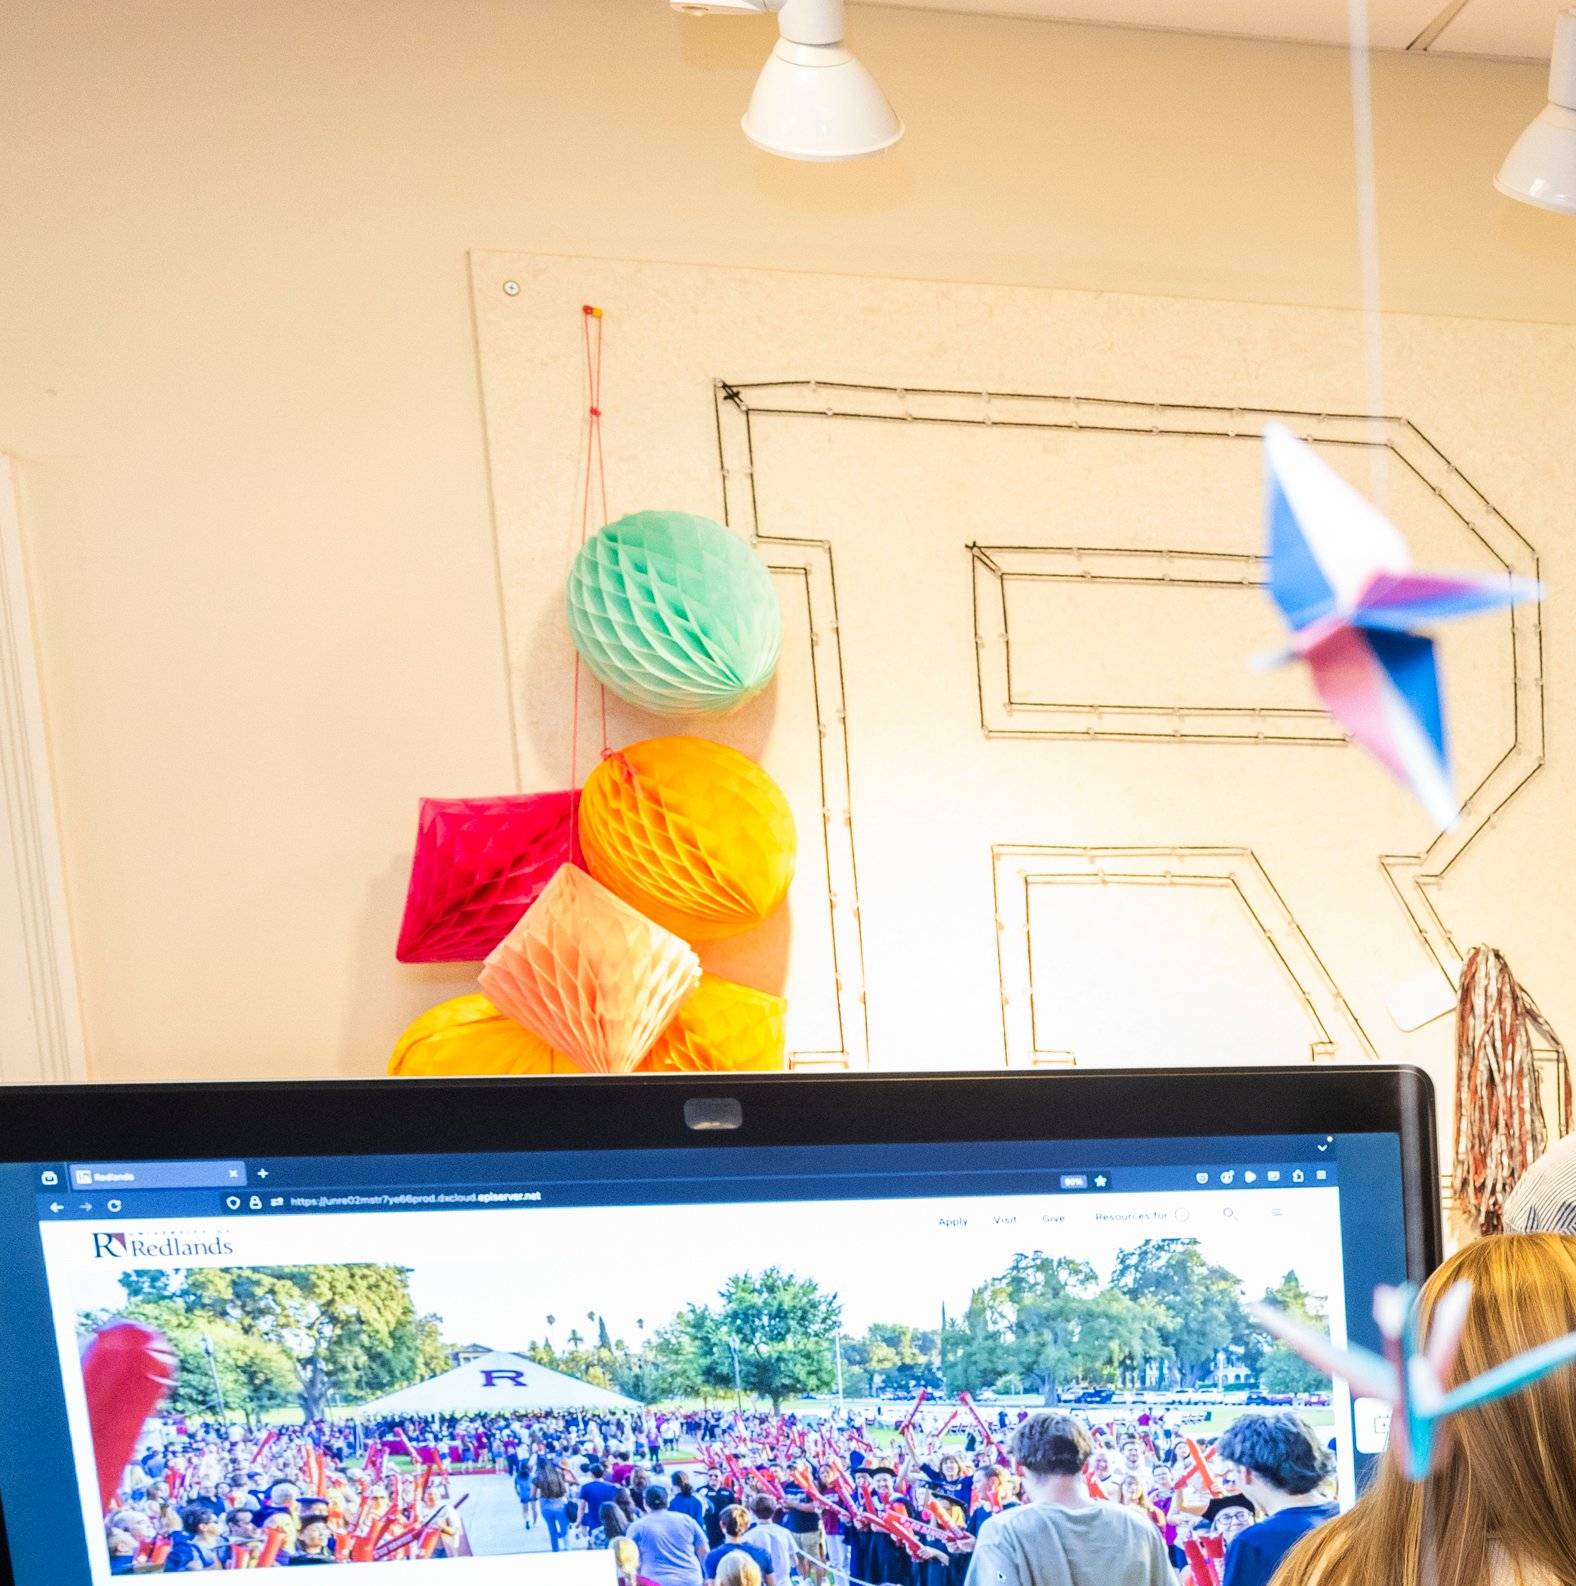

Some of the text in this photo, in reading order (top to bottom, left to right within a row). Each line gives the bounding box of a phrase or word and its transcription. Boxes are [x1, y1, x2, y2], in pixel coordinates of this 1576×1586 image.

[938, 1212, 1150, 1227] Apply Resources
[131, 1236, 233, 1257] Redlands
[481, 1368, 528, 1388] R
